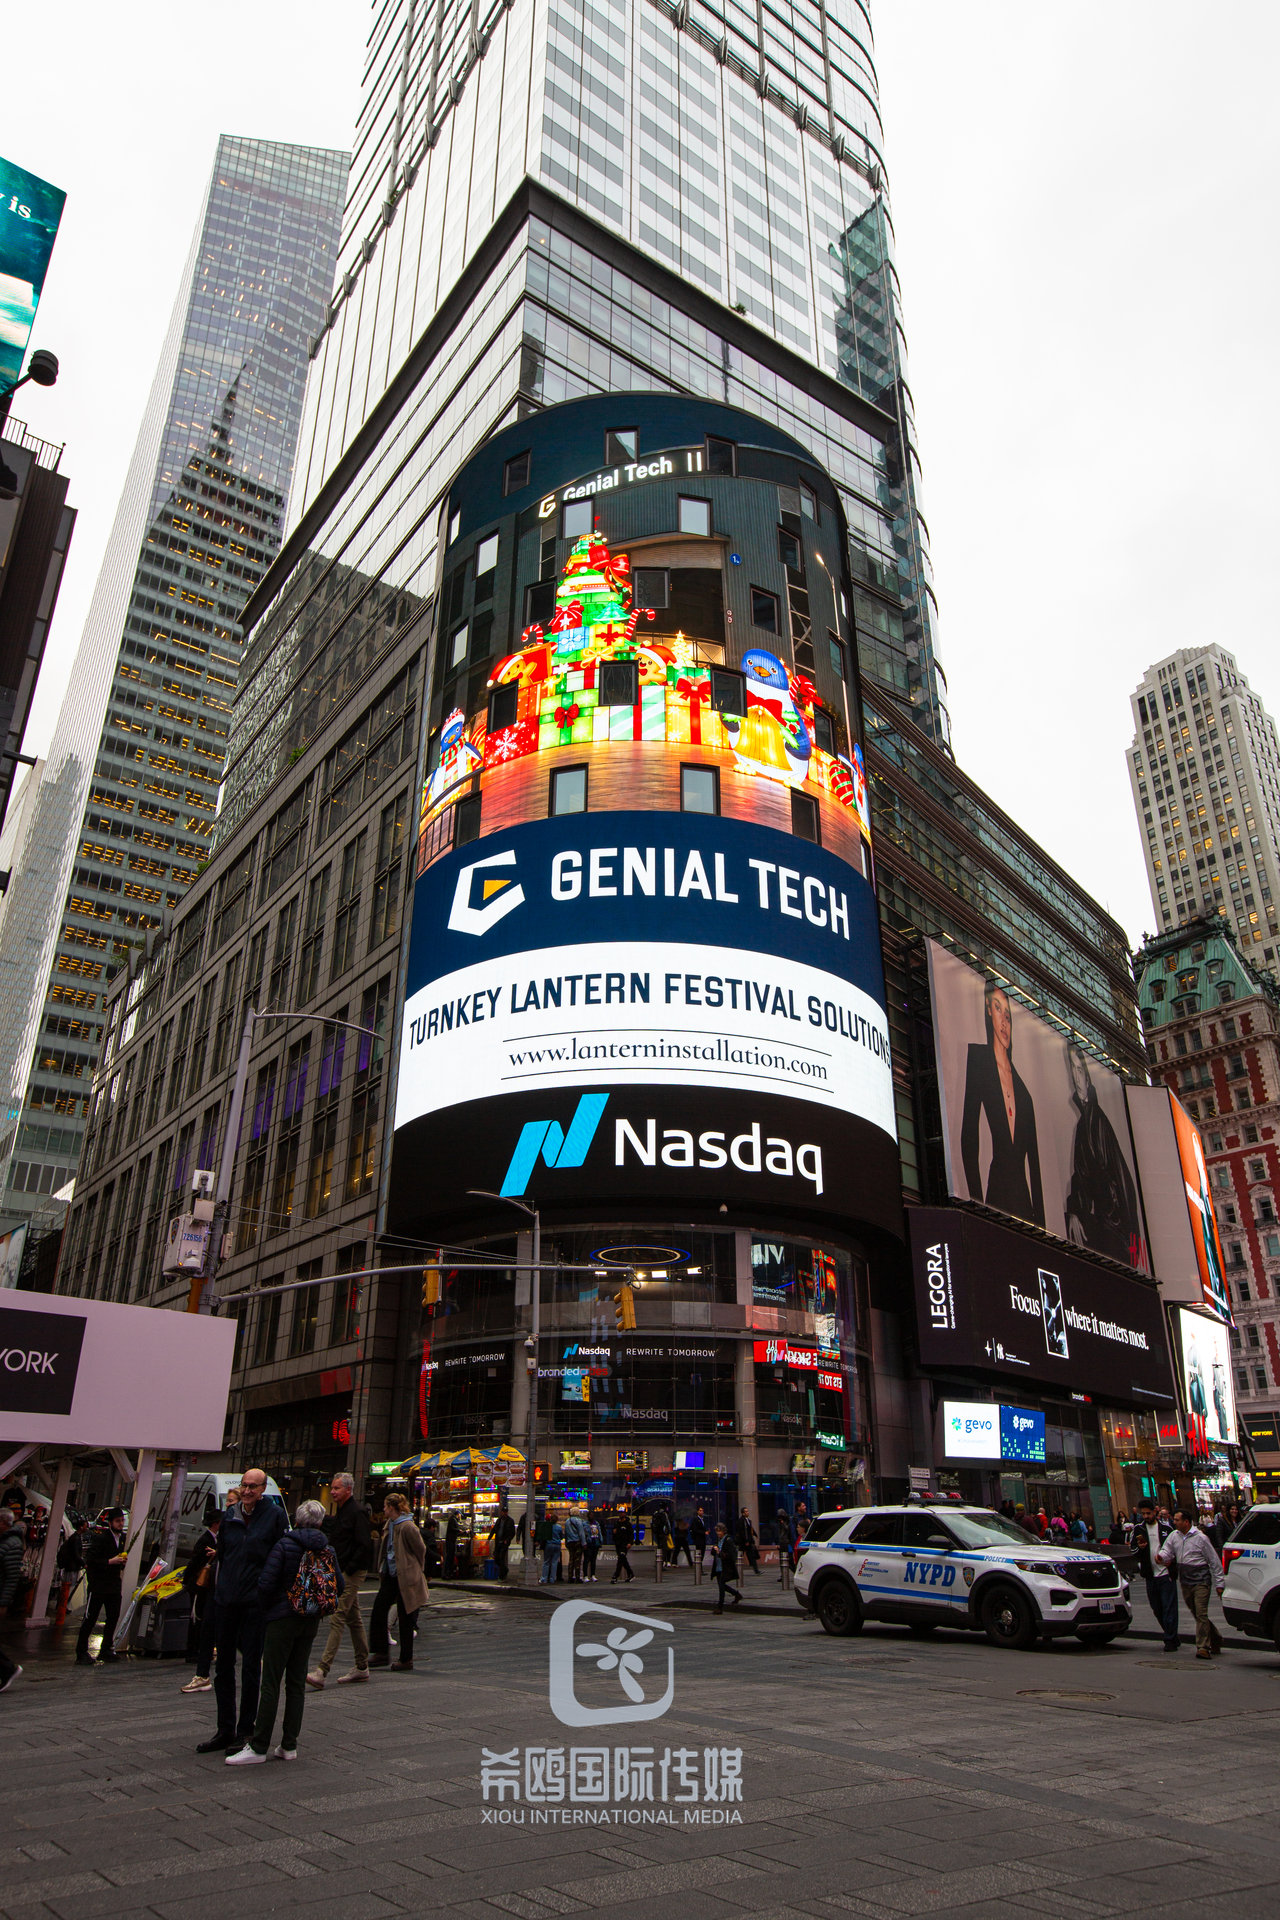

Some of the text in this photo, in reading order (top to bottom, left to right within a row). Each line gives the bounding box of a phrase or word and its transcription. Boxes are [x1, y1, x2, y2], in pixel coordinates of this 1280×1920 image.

[8, 195, 32, 219] is
[563, 468, 619, 501] Genial
[624, 456, 673, 482] Tech
[550, 847, 739, 904] GENIAL
[748, 857, 850, 941] TECH
[409, 972, 891, 1070] TURNKEY LANTERN FESTIVAL SOLUTIONS
[509, 1038, 828, 1081] www.lanterninstallation.com
[614, 1118, 824, 1196] Nasdaq
[925, 1243, 949, 1329] LEGORA
[1009, 1284, 1149, 1350] Focus where it matters most.
[445, 1356, 467, 1367] REWRITE
[469, 1353, 505, 1363] TOMORROW
[578, 1346, 716, 1357] Nasdaq REWRITE TOMORROW
[622, 1407, 669, 1422] Nasdaq
[965, 1419, 993, 1434] gevo
[1019, 1416, 1035, 1432] gevo
[985, 1555, 1006, 1563] POLICE
[903, 1561, 956, 1587] NYPD
